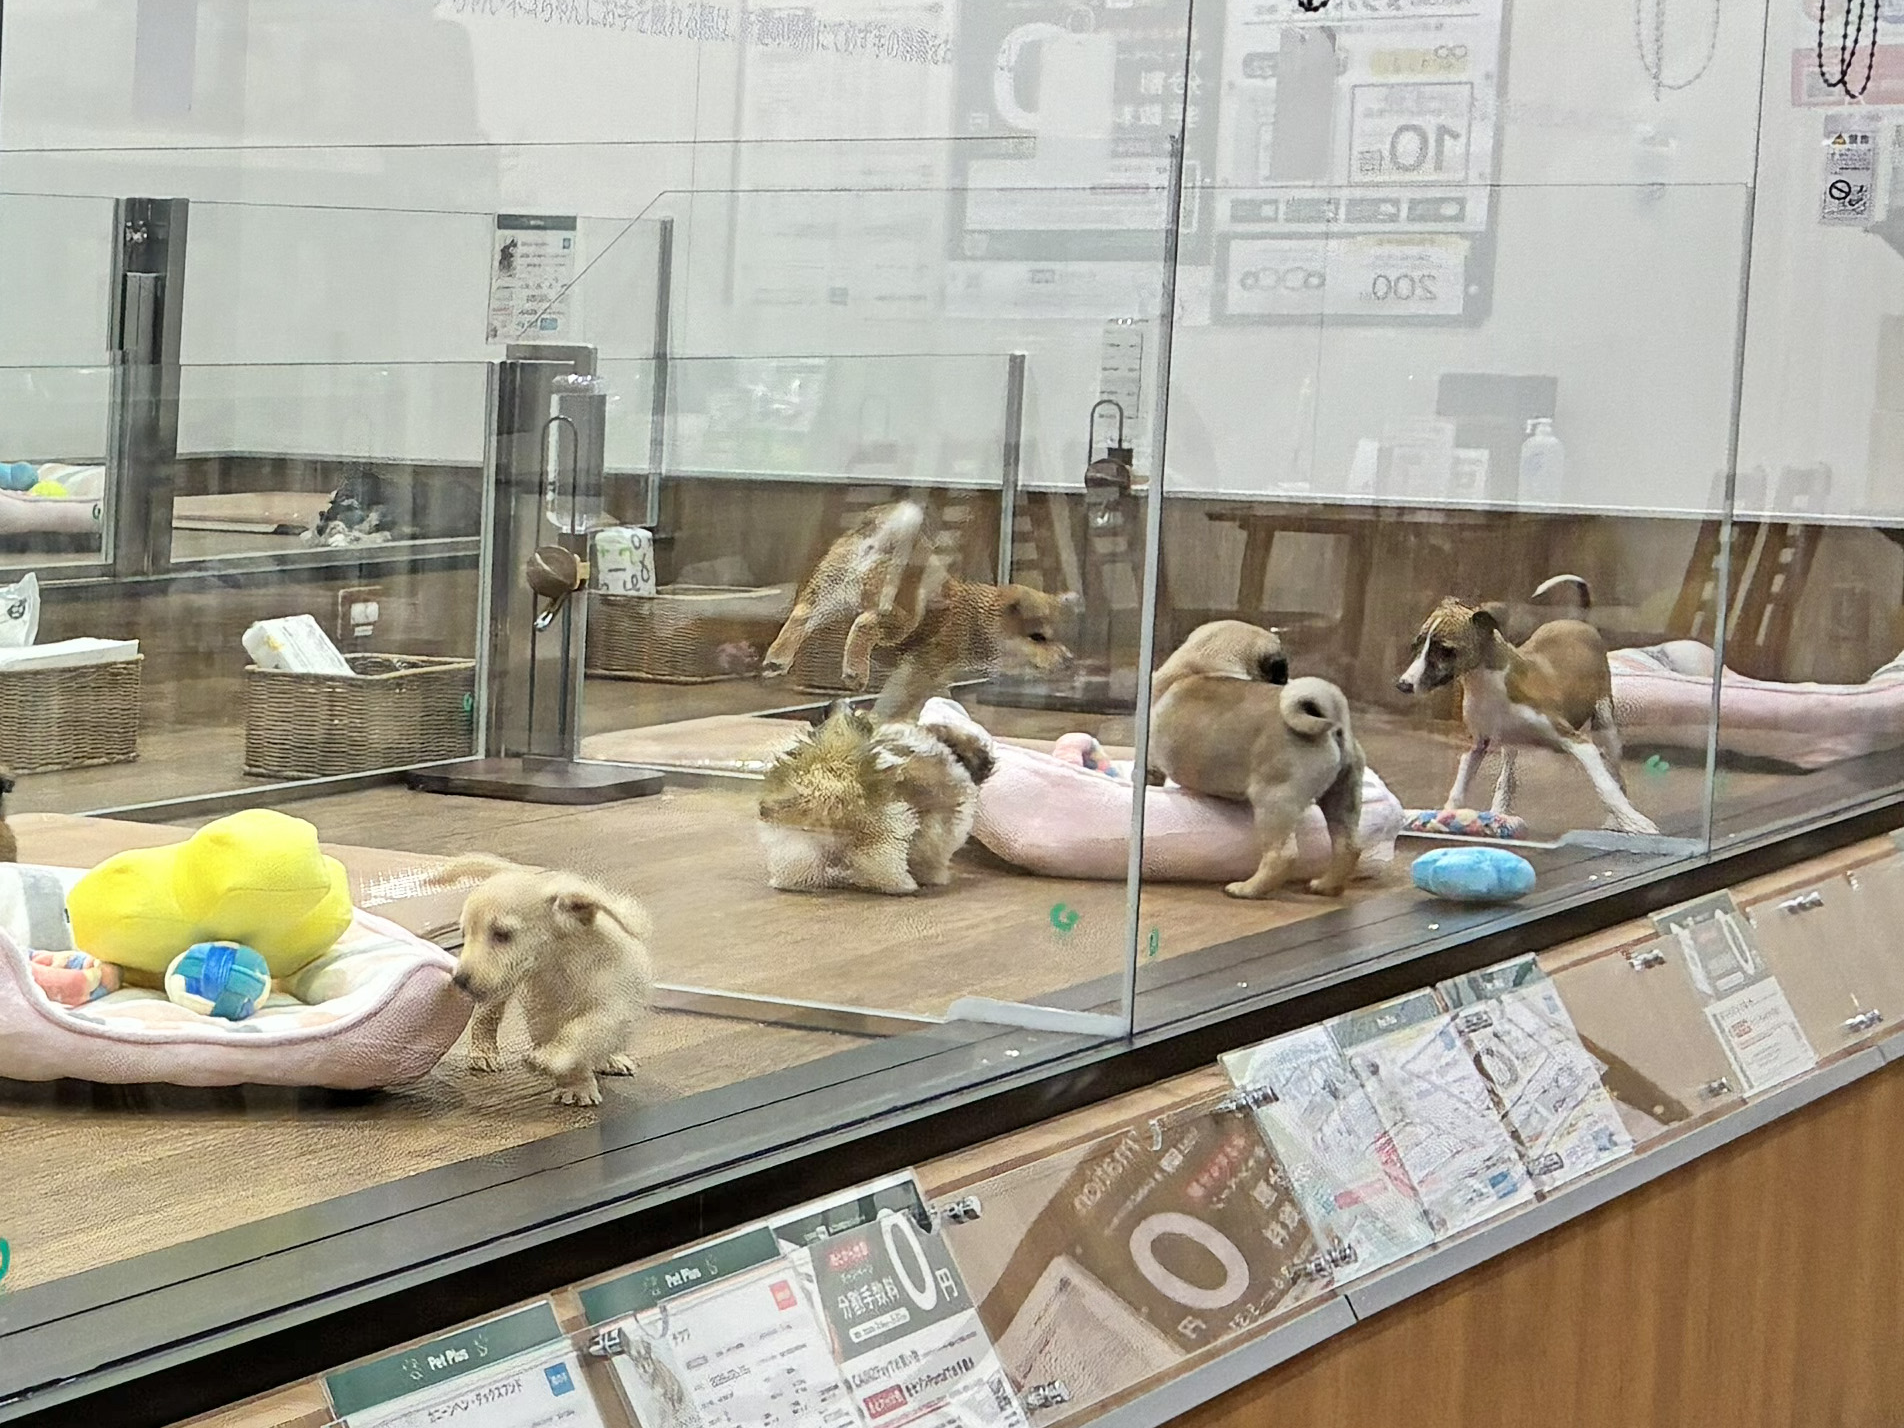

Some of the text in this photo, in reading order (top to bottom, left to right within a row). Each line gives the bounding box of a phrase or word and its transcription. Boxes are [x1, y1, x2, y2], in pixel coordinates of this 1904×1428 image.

[876, 1207, 937, 1311] 0
[837, 1274, 900, 1321] 分割手数料
[935, 1267, 959, 1302] 円
